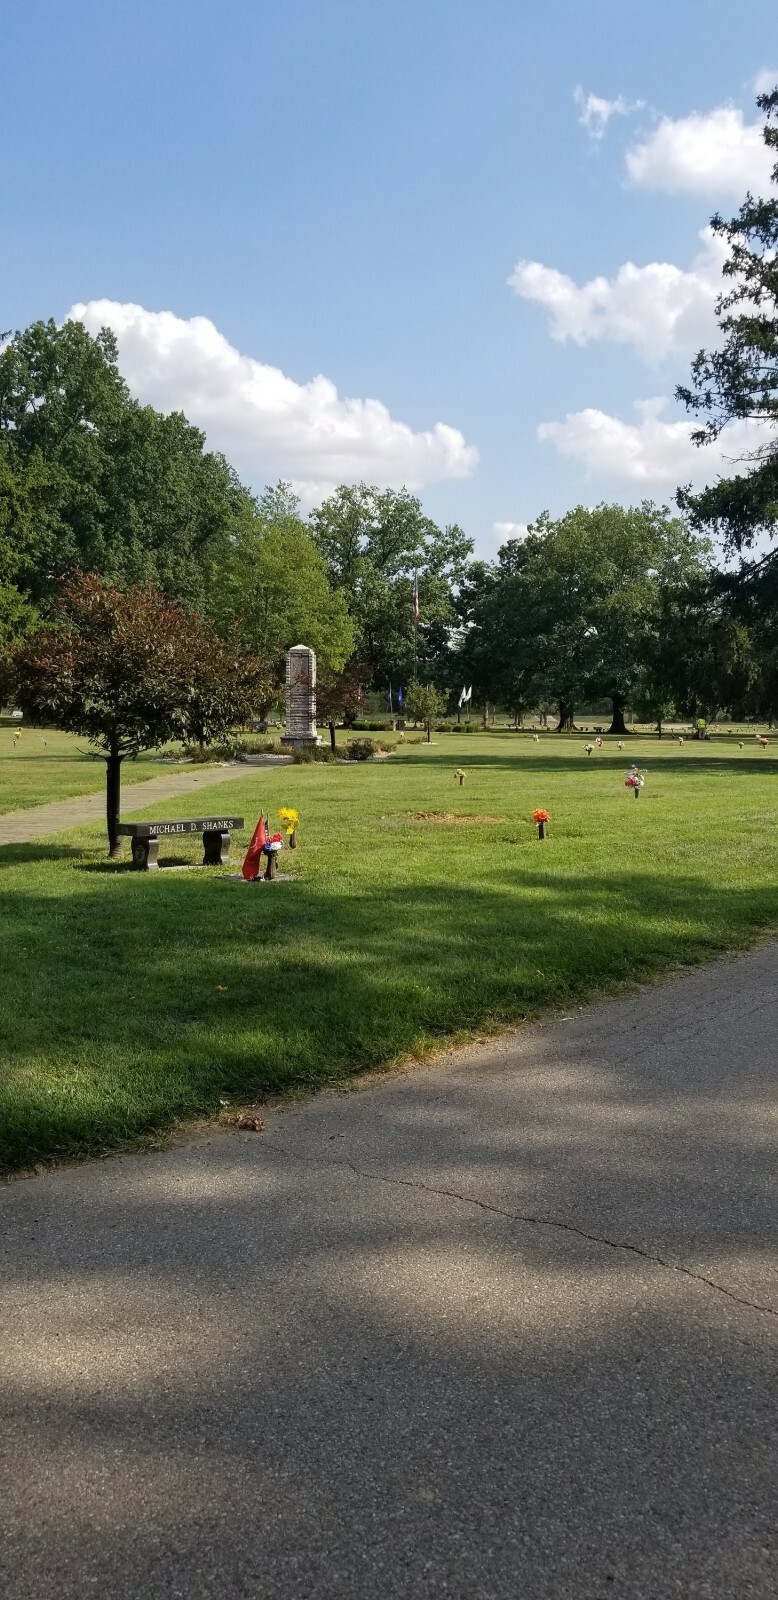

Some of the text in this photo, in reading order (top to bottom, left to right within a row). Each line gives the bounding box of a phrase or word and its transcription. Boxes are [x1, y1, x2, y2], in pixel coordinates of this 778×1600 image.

[149, 820, 234, 835] MICHAEL D. SHANKS
